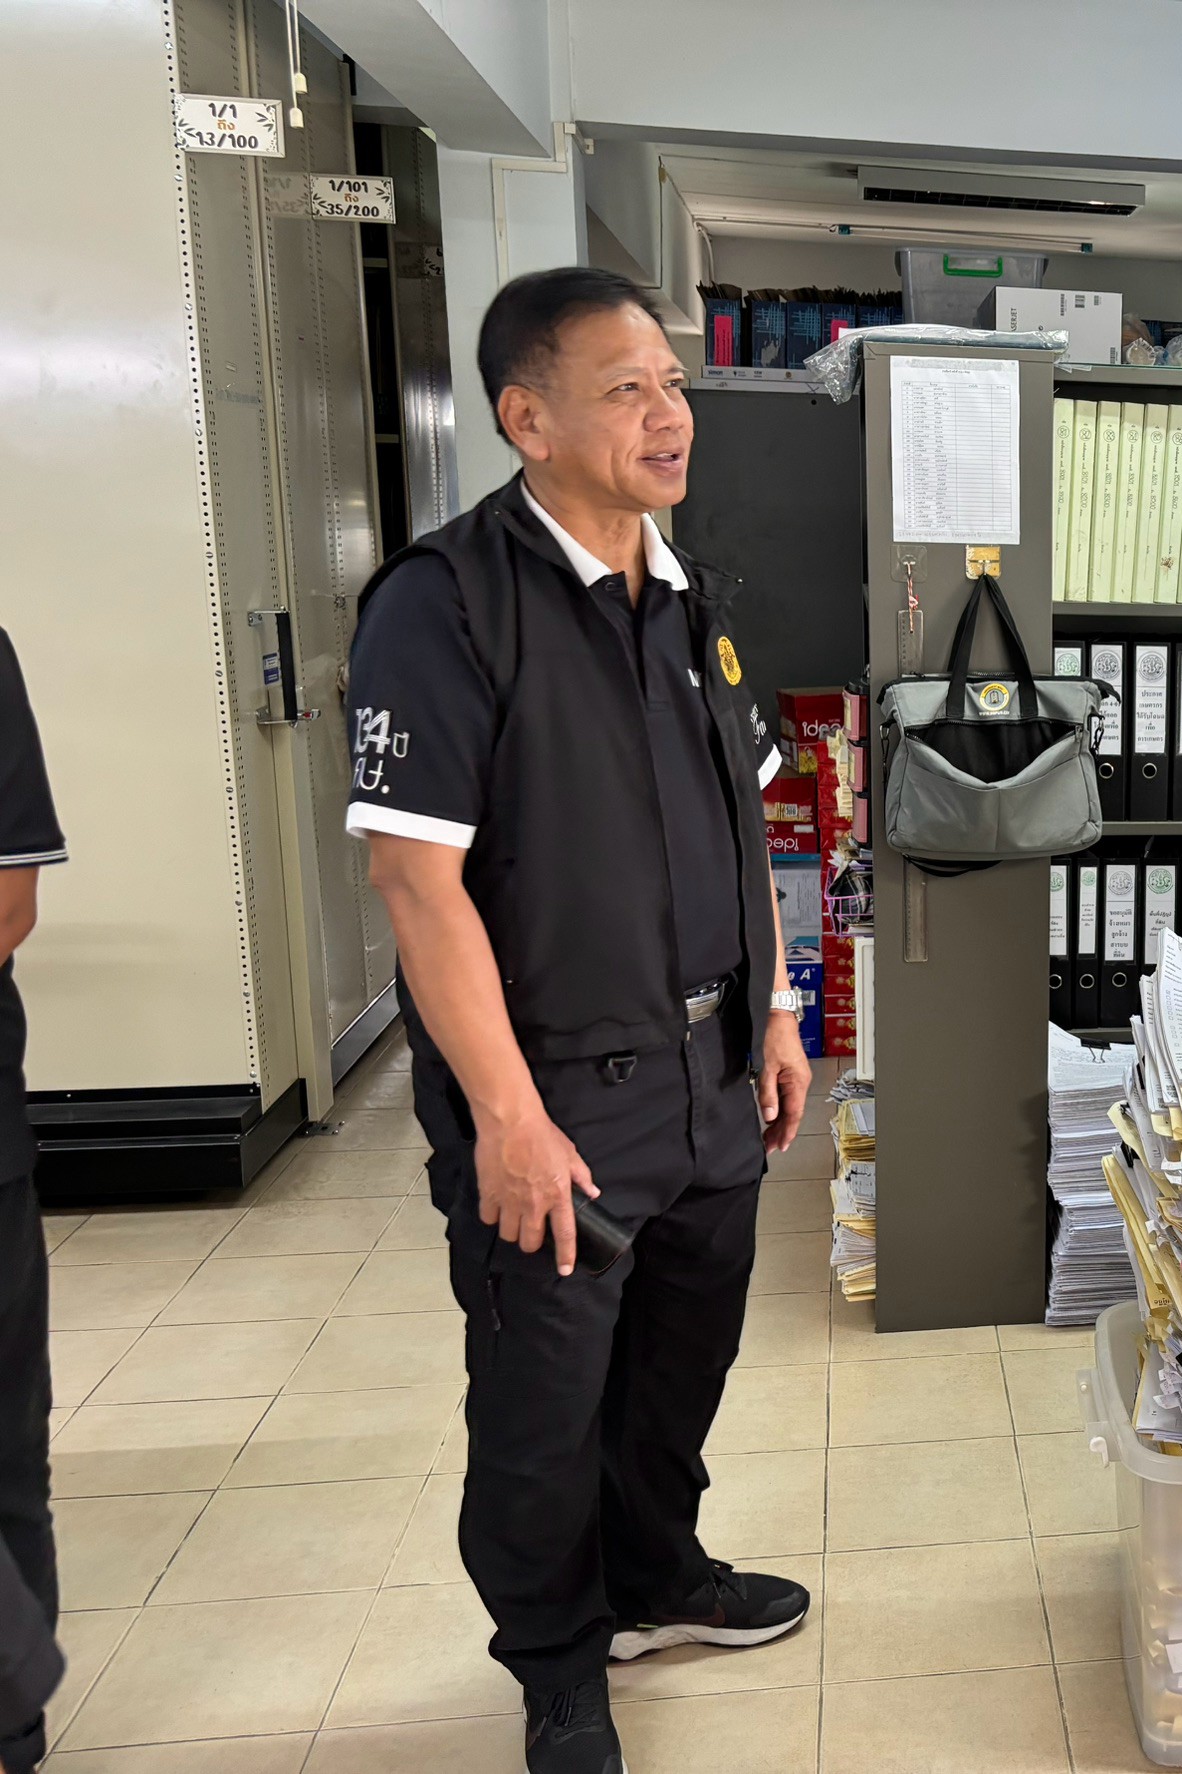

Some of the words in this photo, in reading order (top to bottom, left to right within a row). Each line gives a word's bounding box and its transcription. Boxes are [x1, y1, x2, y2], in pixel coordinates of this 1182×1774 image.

[208, 103, 238, 119] 1/1
[216, 118, 236, 131] ถึง
[195, 131, 259, 149] 13/100
[328, 179, 369, 193] 1/101
[344, 192, 359, 203] ถึง
[326, 203, 380, 217] 35/200
